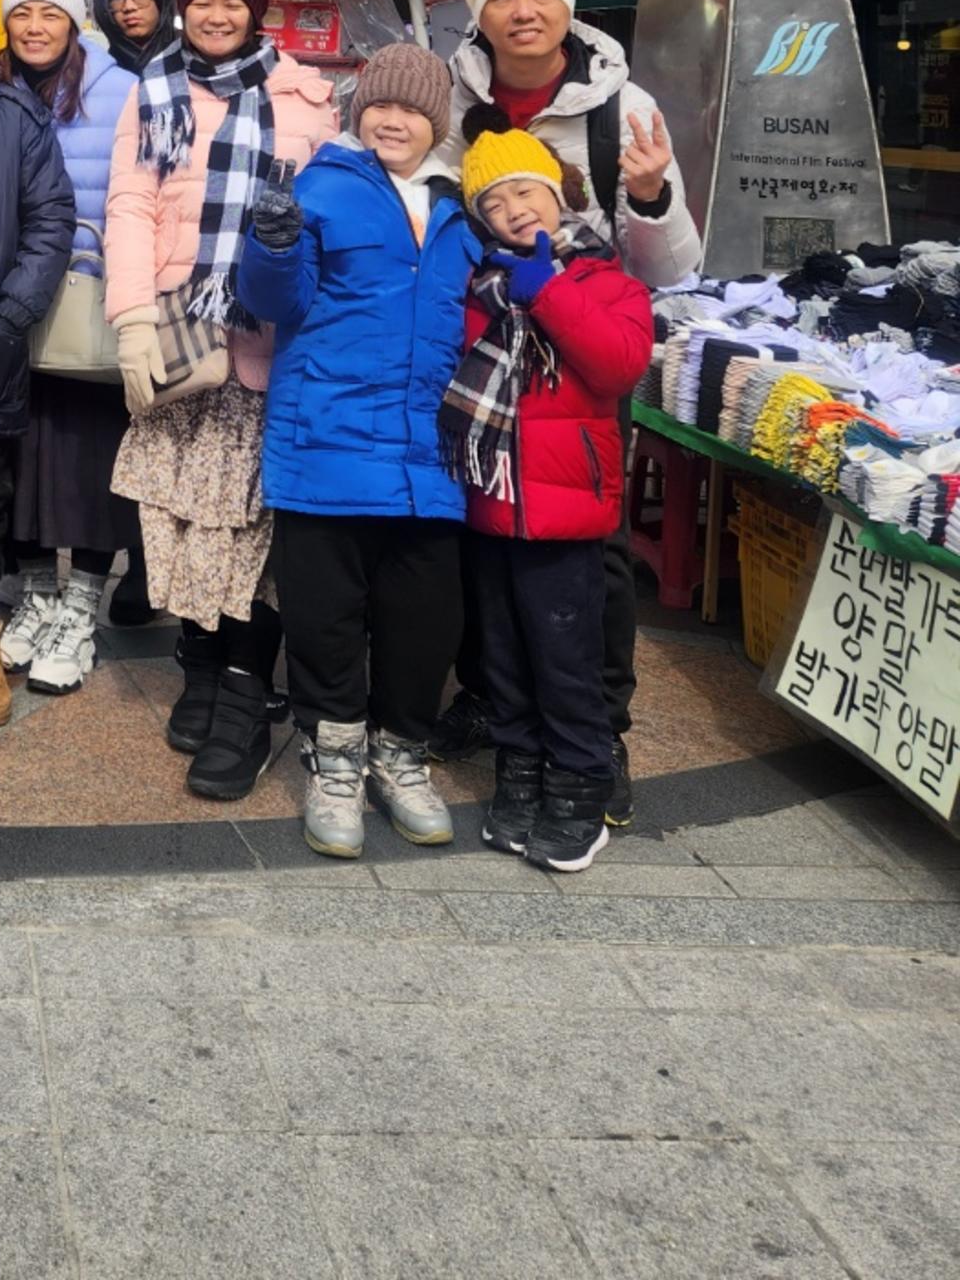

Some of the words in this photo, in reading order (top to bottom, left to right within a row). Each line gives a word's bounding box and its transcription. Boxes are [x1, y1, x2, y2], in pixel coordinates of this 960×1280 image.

[763, 117, 830, 135] BUSAN
[731, 151, 799, 166] International
[829, 520, 960, 643] 순면발가
[833, 592, 921, 697] 양말
